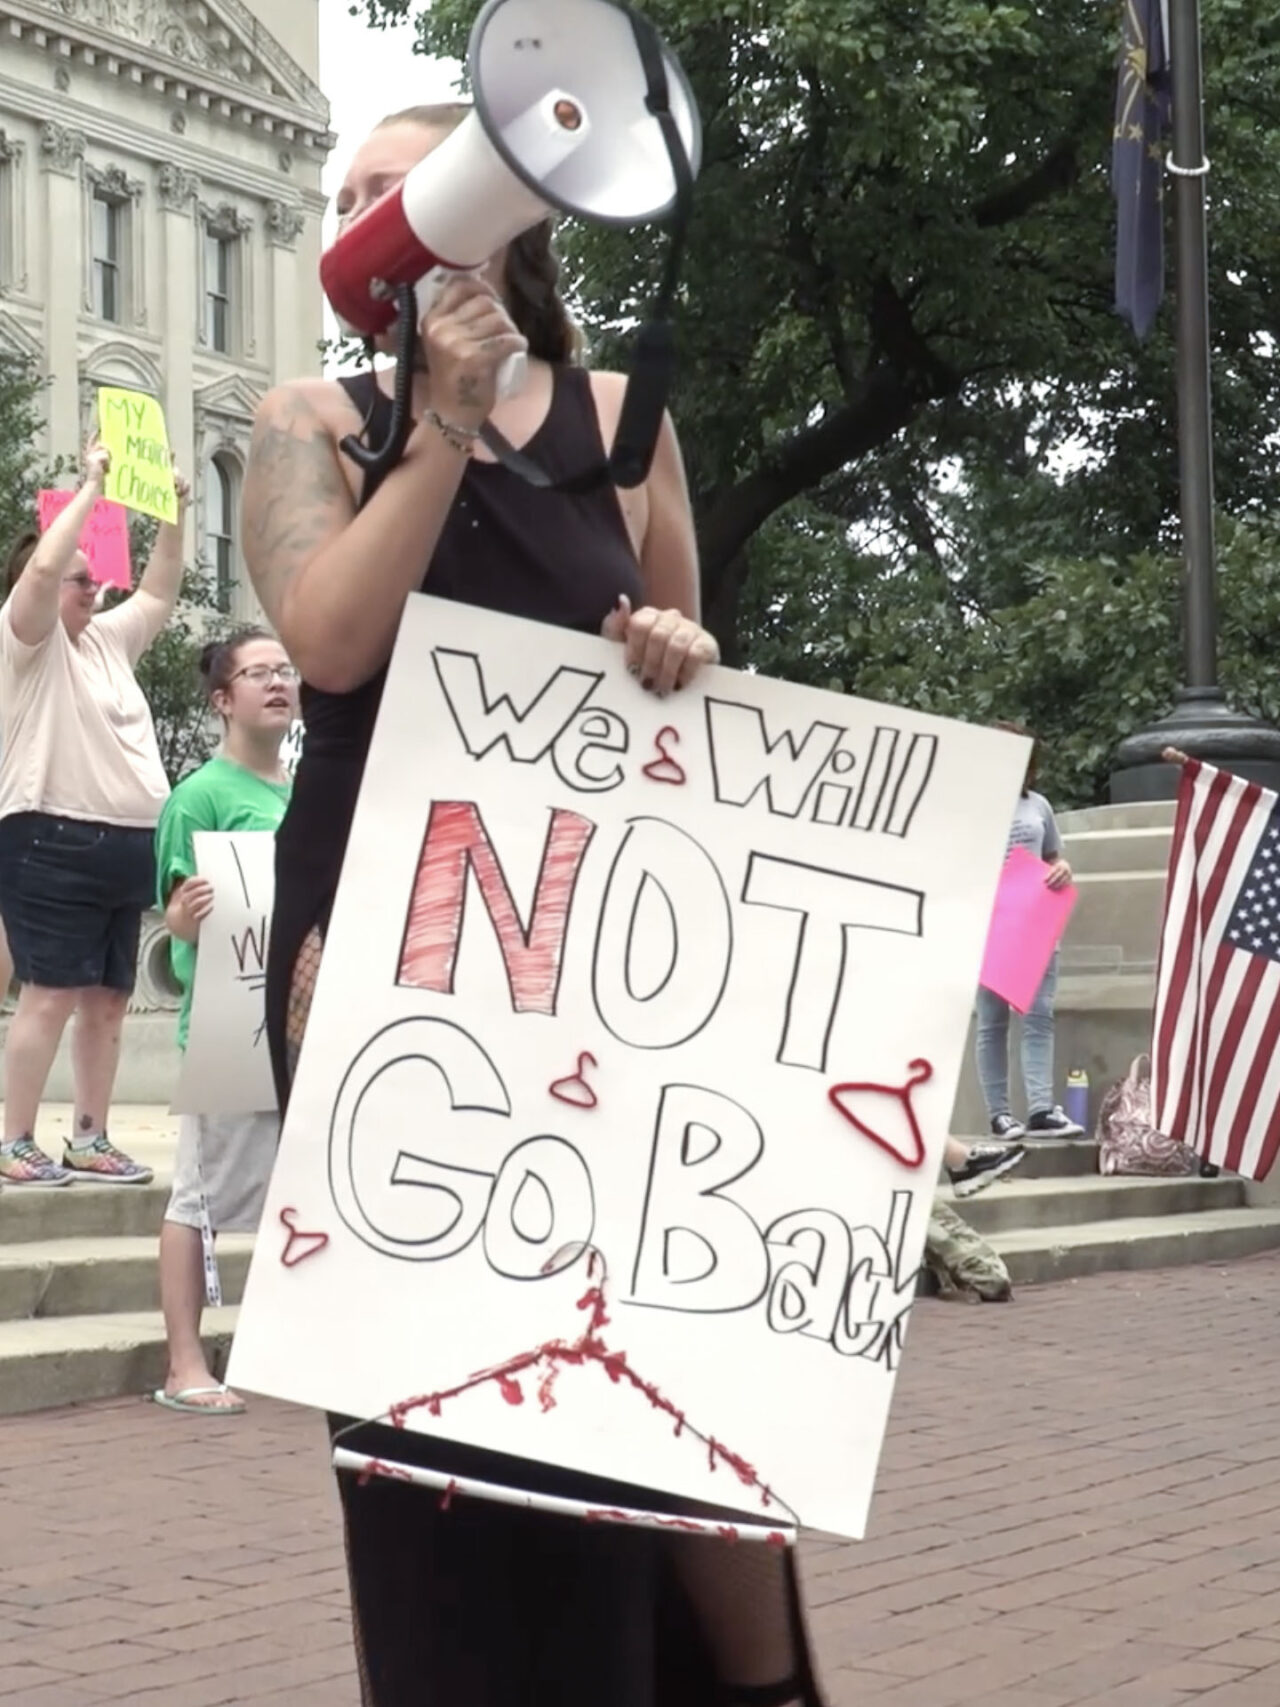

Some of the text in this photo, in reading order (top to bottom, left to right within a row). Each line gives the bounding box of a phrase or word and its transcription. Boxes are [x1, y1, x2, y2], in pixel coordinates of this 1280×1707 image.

[105, 397, 146, 430] MY
[430, 646, 939, 838] We Will
[394, 799, 926, 1073] NOT
[326, 1015, 597, 1281] Go
[618, 1082, 922, 1372] Back
